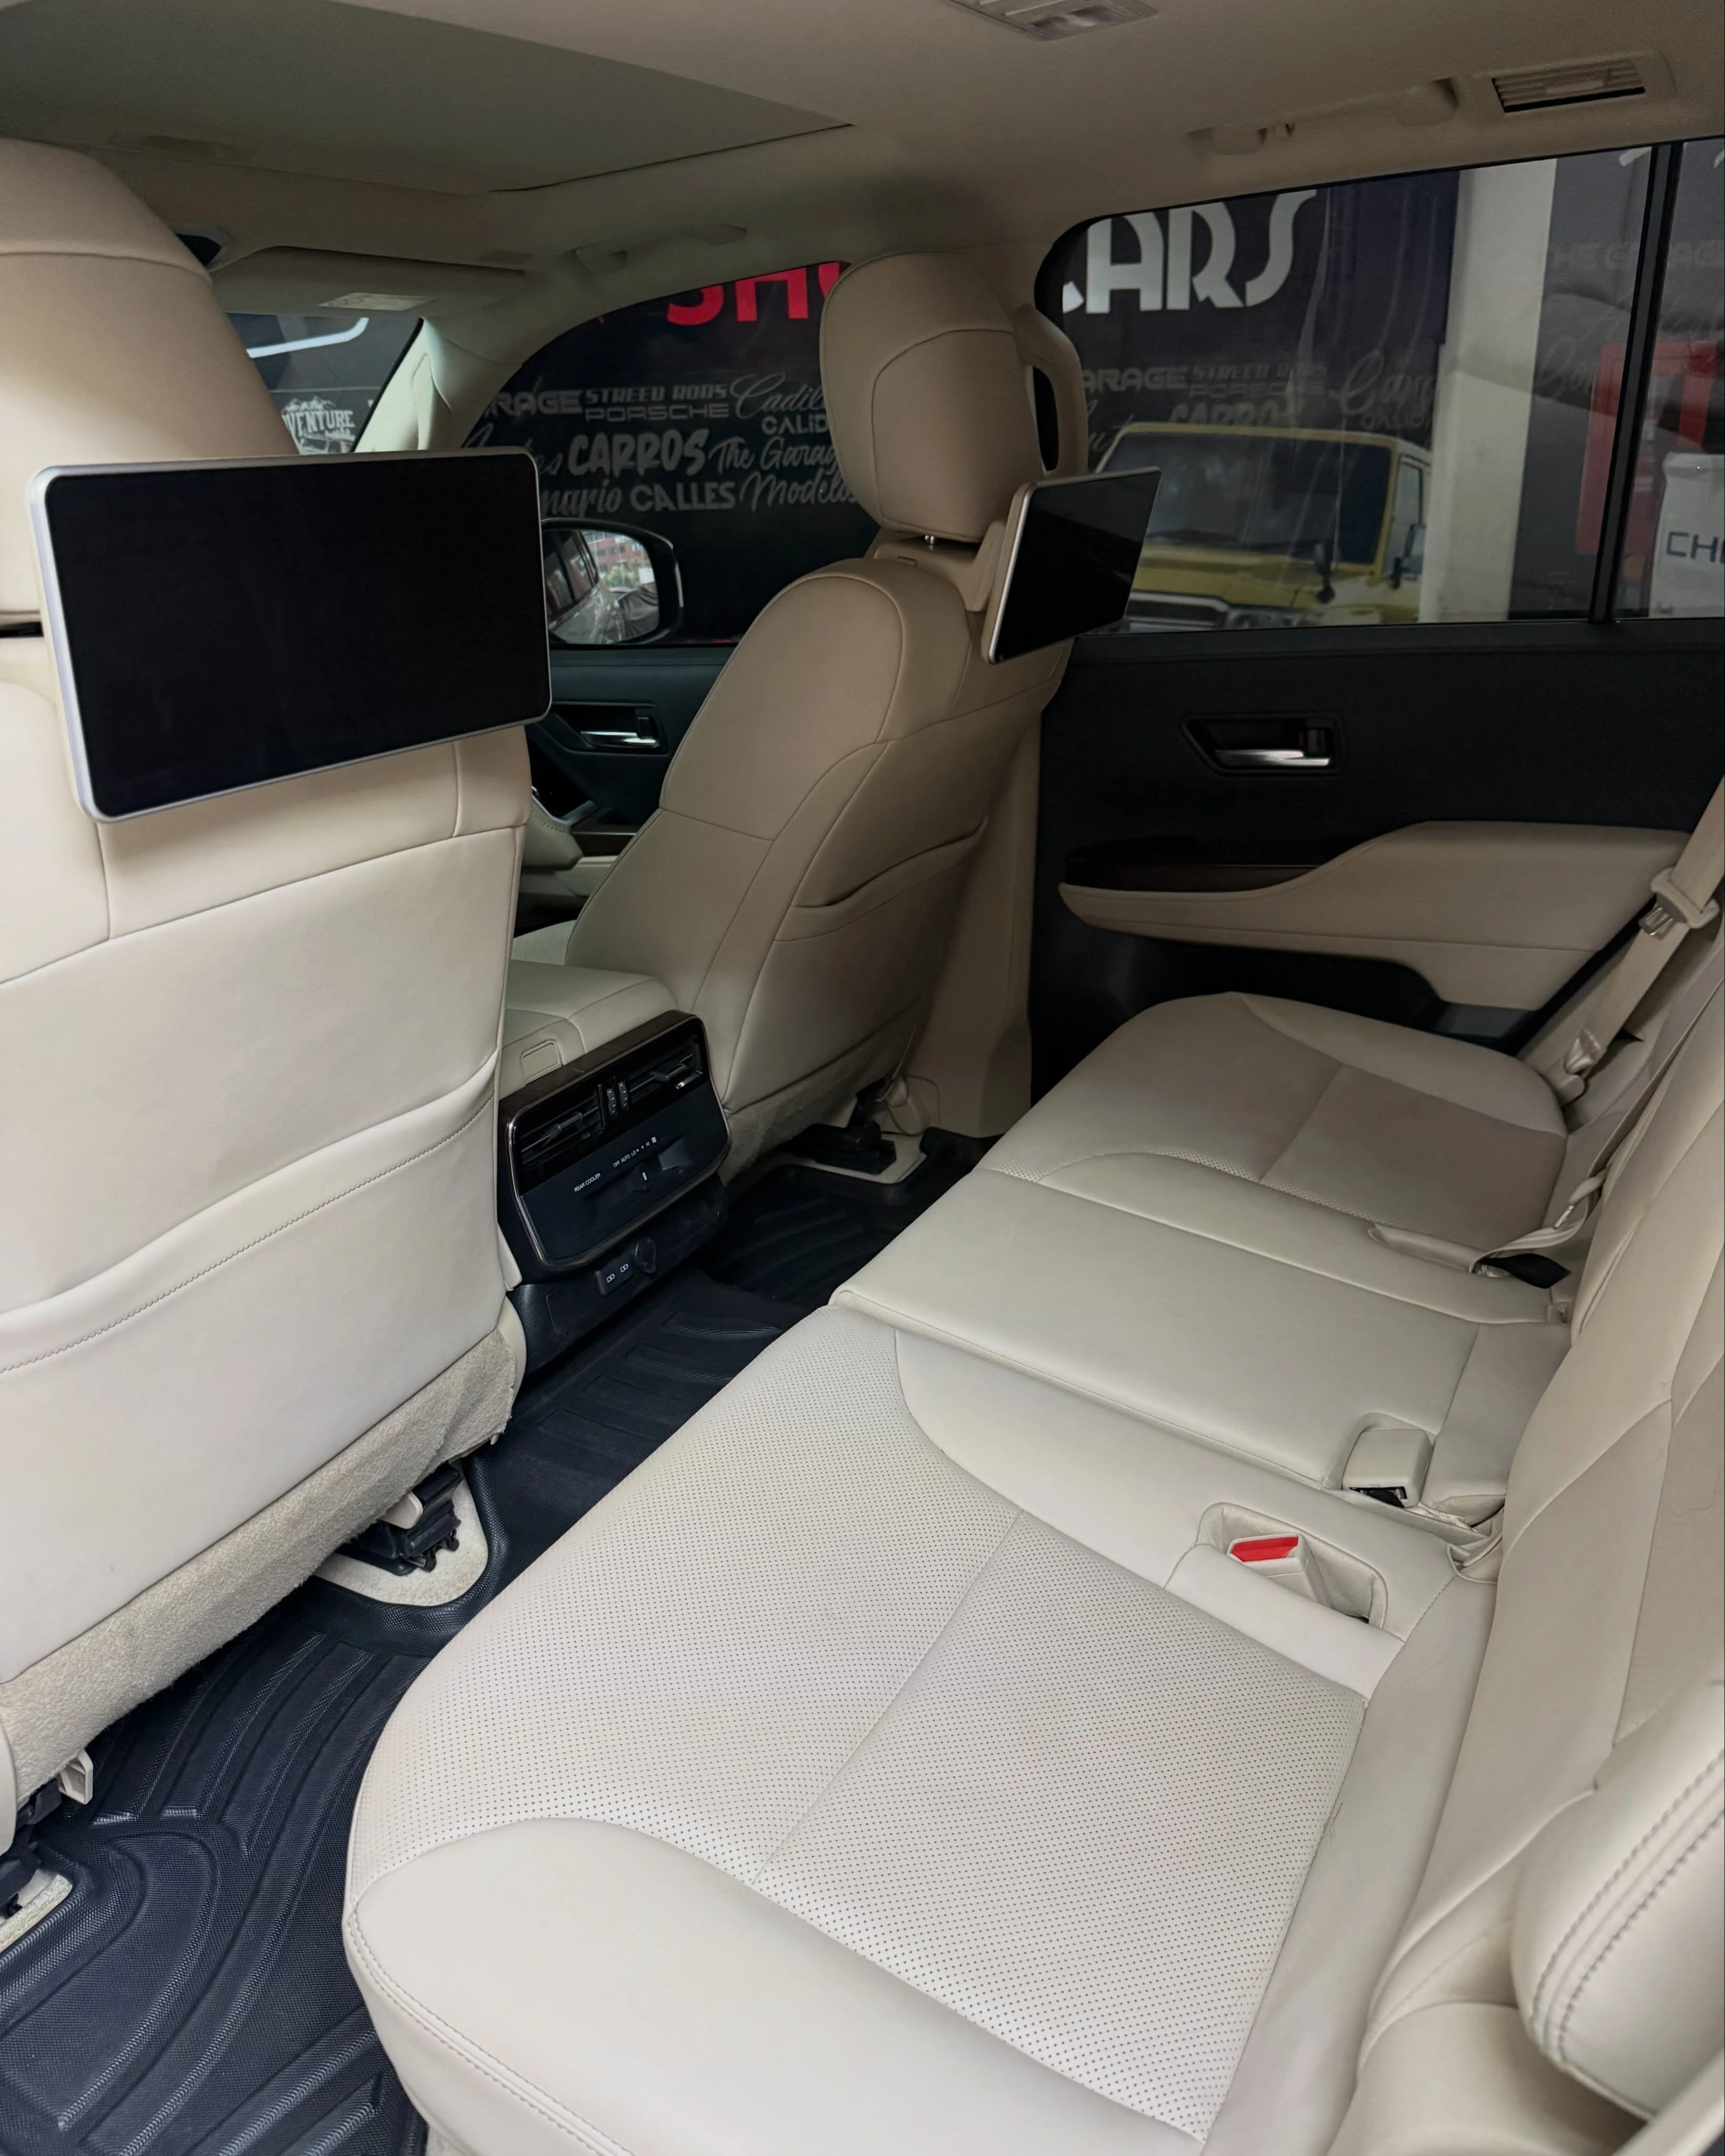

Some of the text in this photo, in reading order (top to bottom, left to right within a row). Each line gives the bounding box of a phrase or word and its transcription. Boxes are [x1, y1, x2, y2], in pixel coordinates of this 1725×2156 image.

[1062, 190, 1318, 315] ARS
[485, 390, 583, 418] RAGE
[585, 403, 729, 423] PORSCHE
[283, 410, 355, 437] VENTURE
[568, 428, 710, 478] CARROS
[708, 436, 755, 475] The
[630, 481, 736, 512] CALLES
[1665, 531, 1725, 565] CH
[621, 1154, 631, 1163] AUTO
[574, 1173, 601, 1193] REAR COOLER
